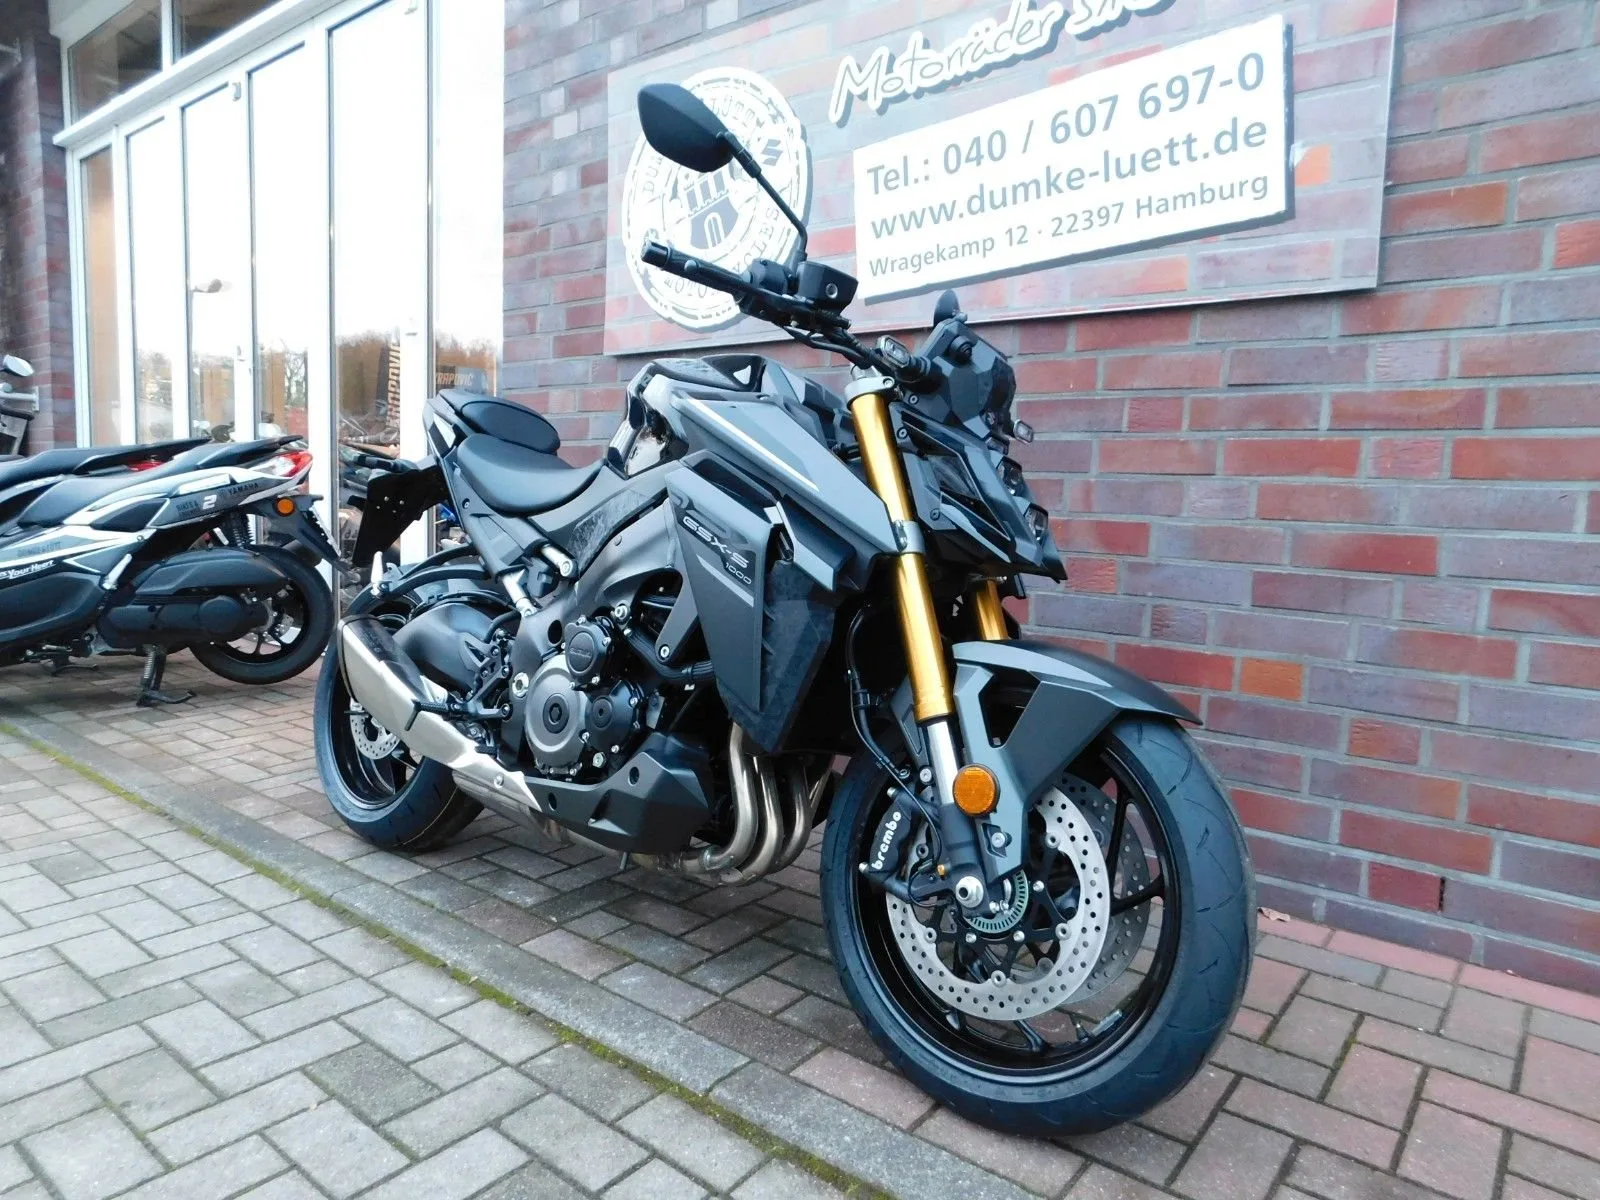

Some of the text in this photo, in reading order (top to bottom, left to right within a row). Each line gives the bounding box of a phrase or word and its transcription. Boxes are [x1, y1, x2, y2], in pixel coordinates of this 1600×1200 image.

[832, 1, 1058, 118] Motorräder
[866, 155, 930, 195] Tel.:
[943, 129, 1007, 174] 040
[1050, 94, 1119, 144] 607
[1138, 52, 1264, 119] 697-0
[870, 116, 1267, 240] www.dumke-luett.de
[868, 236, 996, 277] Wragekamp
[1004, 224, 1029, 247] 12
[1051, 201, 1125, 238] 22397
[1135, 174, 1269, 219] Hamburg
[228, 482, 259, 495] YAMAHA
[682, 516, 750, 569] GSX-S
[724, 562, 752, 585] 1000
[870, 811, 902, 870] brembo
